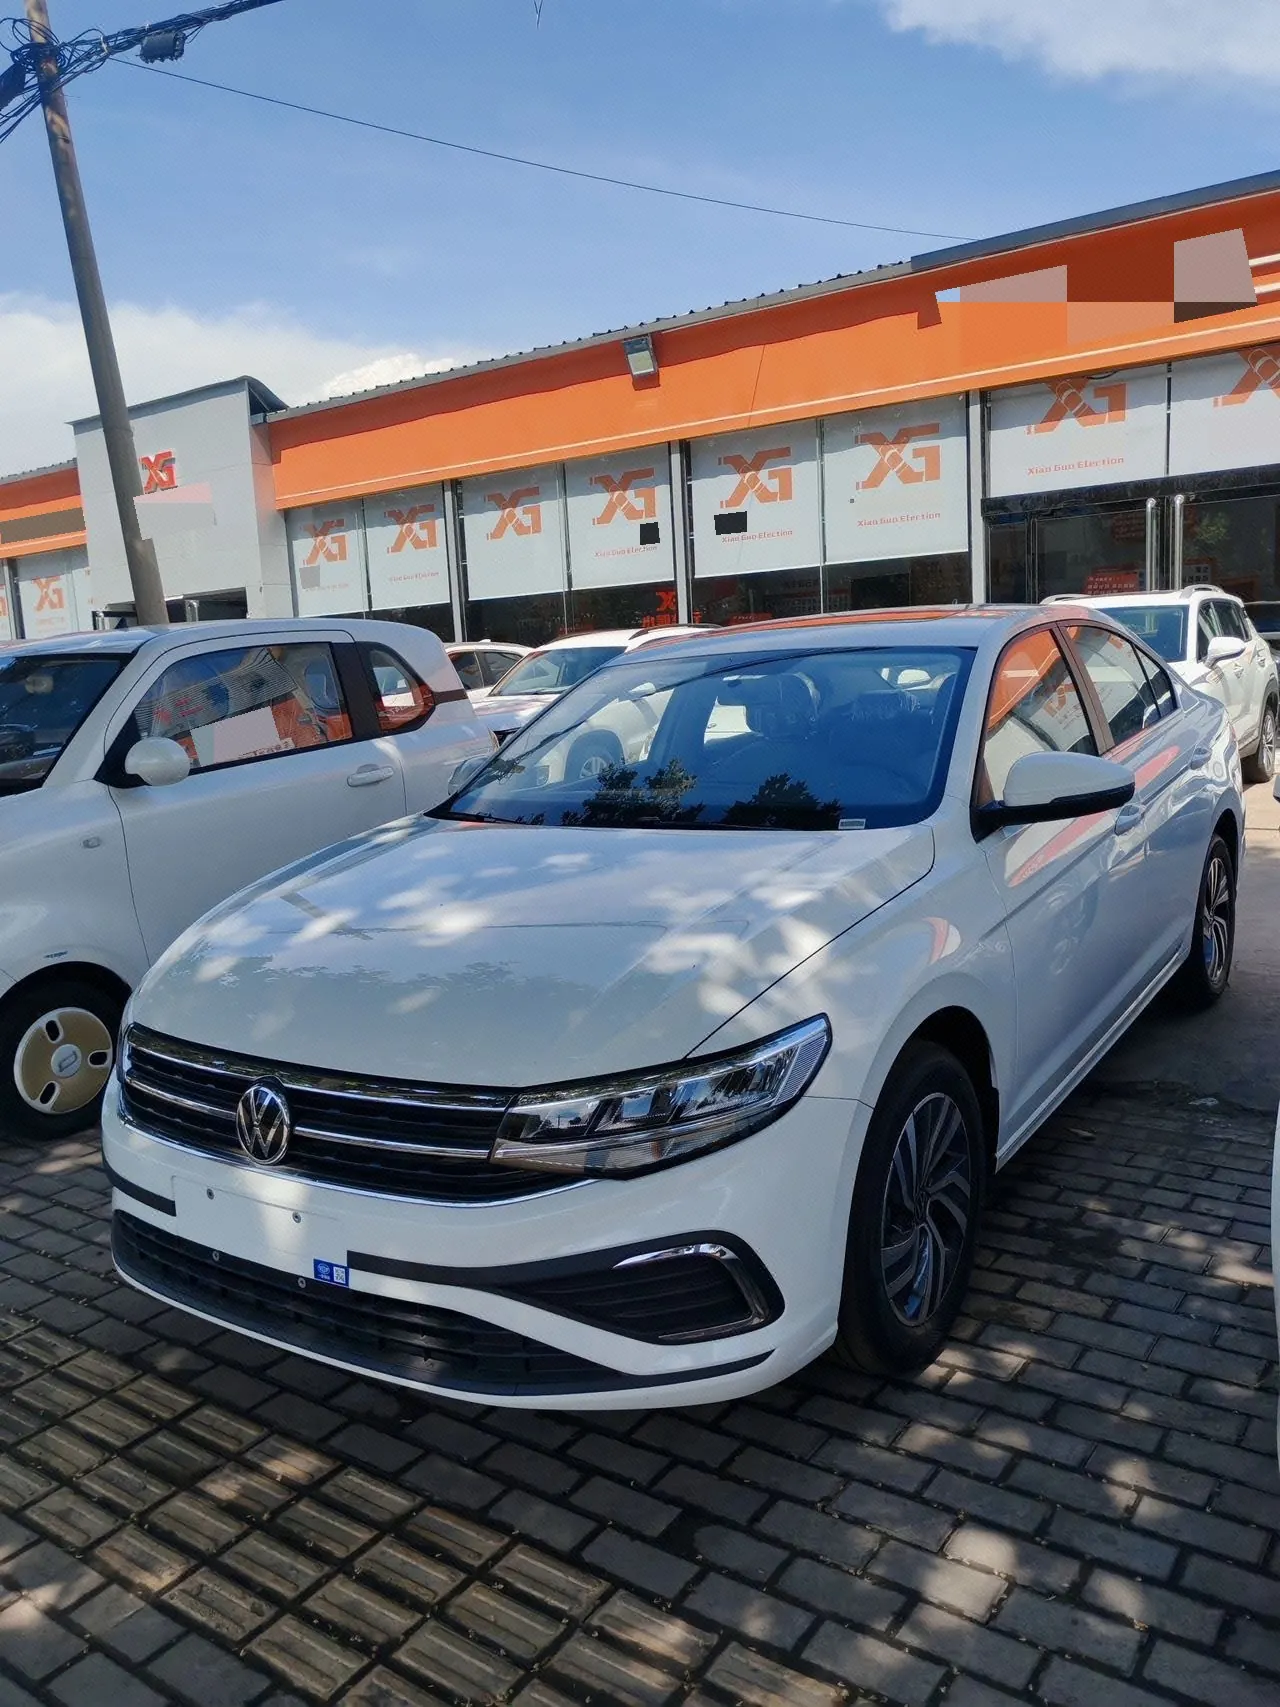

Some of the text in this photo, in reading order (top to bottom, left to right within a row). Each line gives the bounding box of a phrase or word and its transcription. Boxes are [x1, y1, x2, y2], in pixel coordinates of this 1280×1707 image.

[718, 446, 793, 508] XG
[855, 423, 941, 490] XG
[1077, 457, 1124, 469] Election
[484, 486, 542, 541] XG
[590, 467, 657, 526] XG
[383, 503, 438, 555] XG
